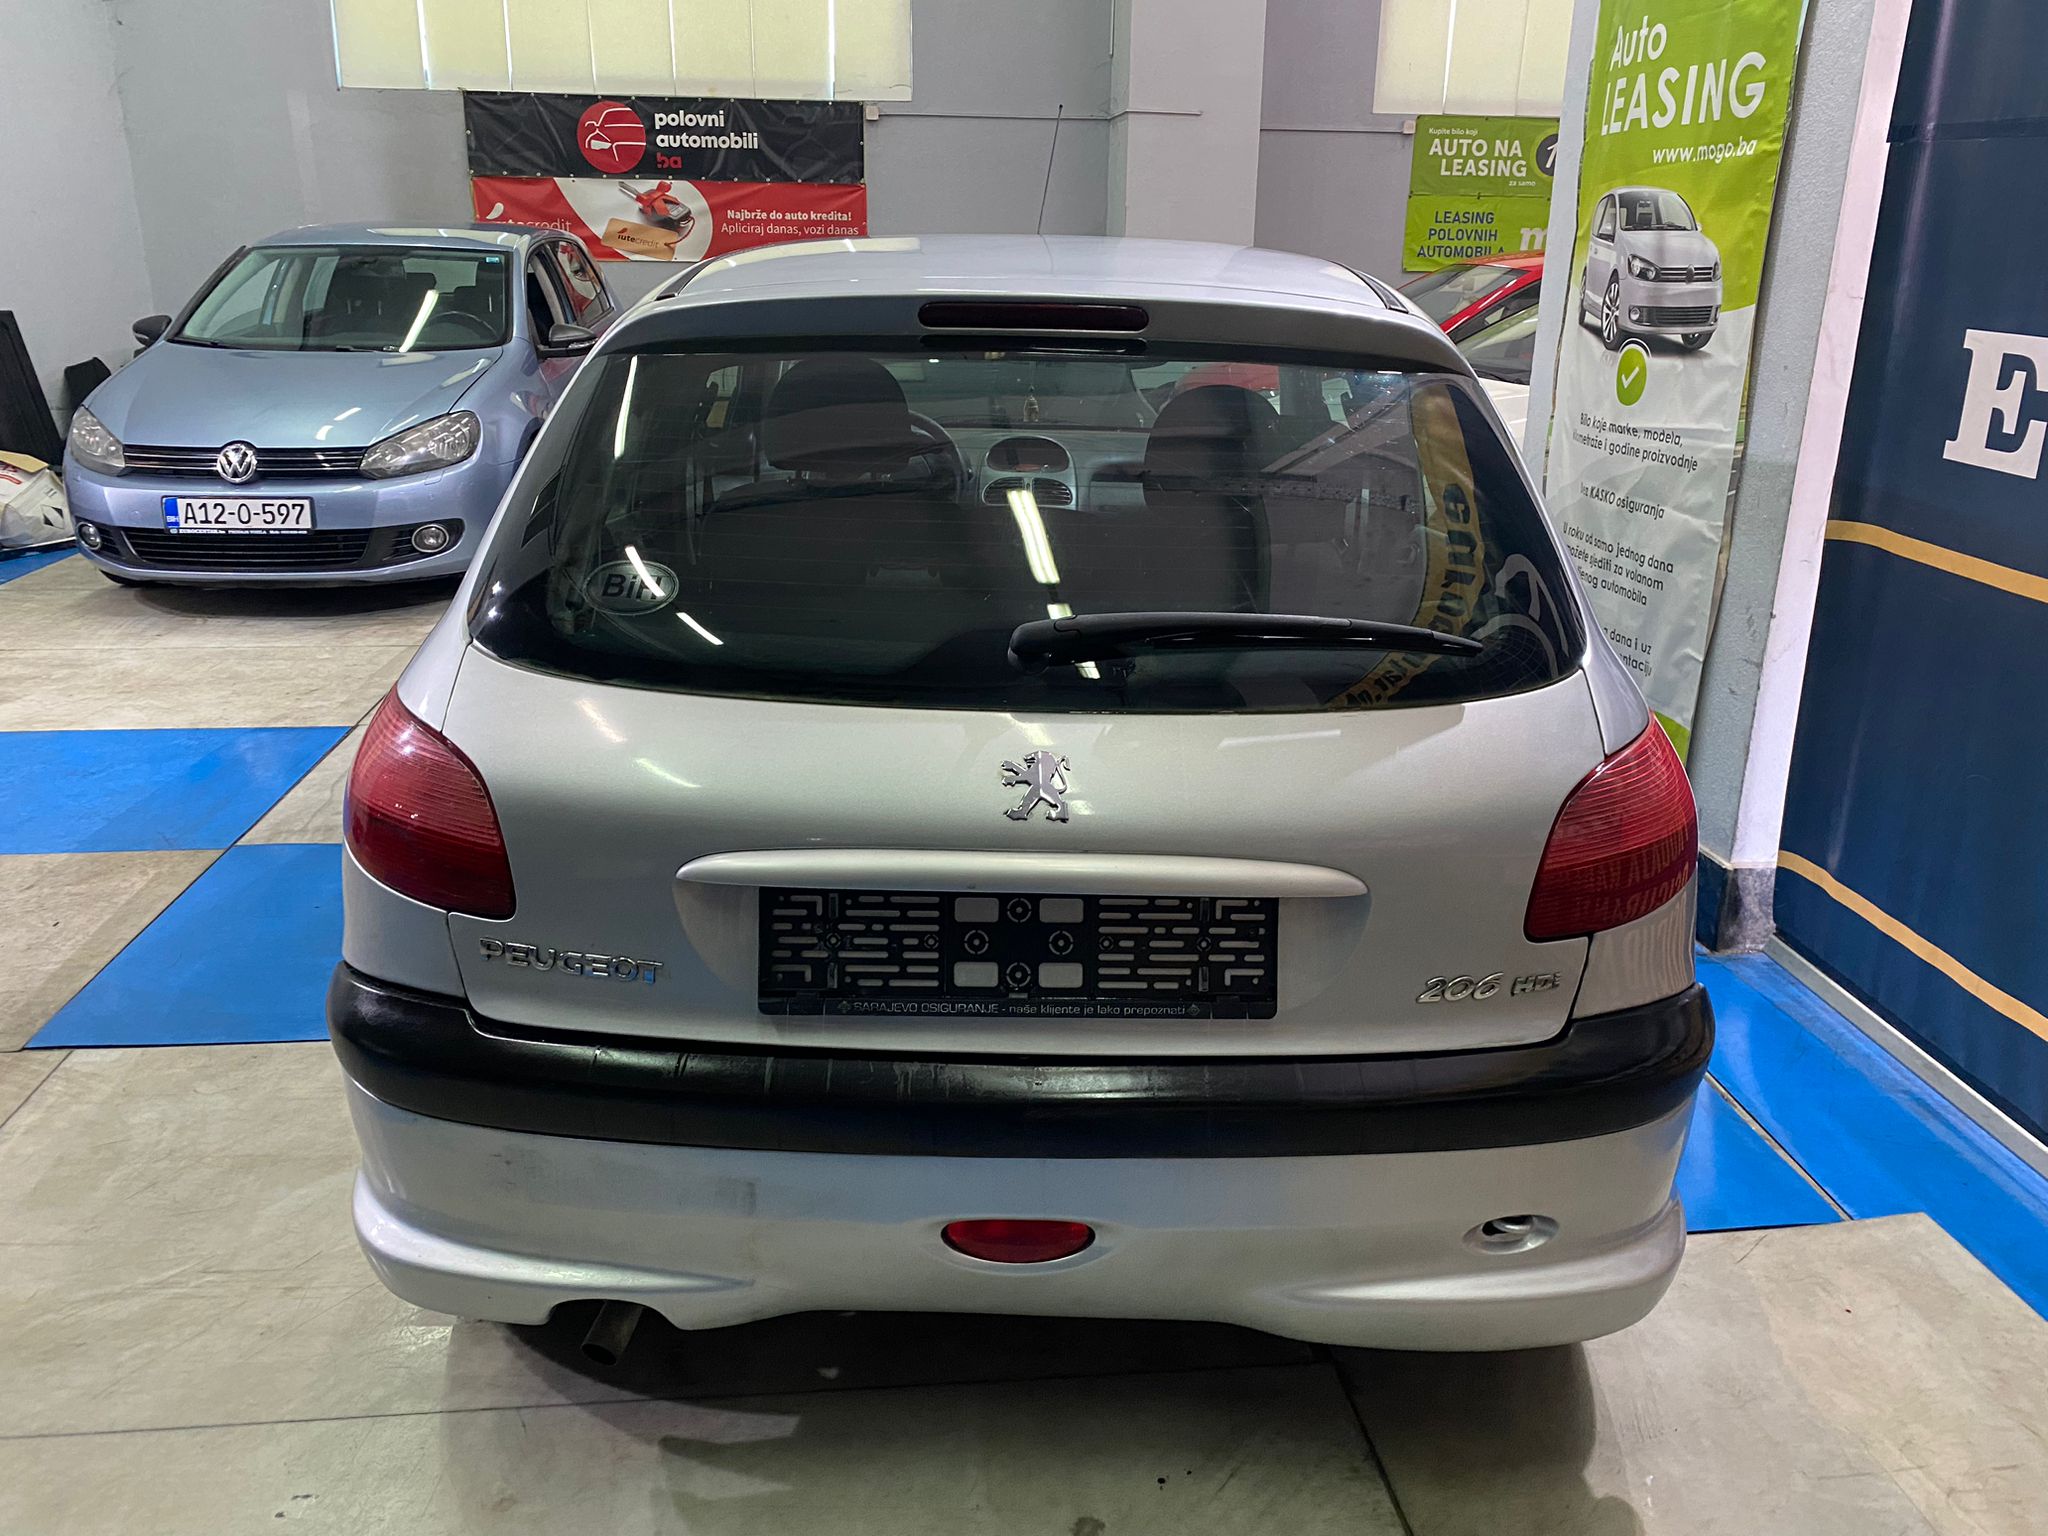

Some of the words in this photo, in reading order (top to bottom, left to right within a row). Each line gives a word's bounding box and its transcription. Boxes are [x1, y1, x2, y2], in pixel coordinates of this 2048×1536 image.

[1609, 15, 1668, 72] Auto
[1601, 51, 1767, 136] LEASING
[654, 109, 725, 129] polovni
[1428, 127, 1450, 136] Kupite
[1465, 129, 1478, 137] koji
[656, 133, 759, 149] automobili
[1428, 138, 1488, 157] AUTO
[1494, 140, 1522, 157] NA
[1652, 136, 1758, 164] www.mogo.ba
[1440, 158, 1527, 177] LEASING
[727, 209, 767, 221] Najbrže
[769, 210, 783, 220] do
[784, 212, 808, 221] auto
[810, 210, 852, 221] kredita!
[1434, 210, 1495, 224] LEASING
[721, 222, 764, 235] Apliciraj
[766, 223, 801, 236] danas,
[803, 225, 825, 235] vozi
[826, 224, 859, 236] danas
[1428, 228, 1498, 241] POLOVNIH
[1580, 412, 1591, 425] Bilo
[1592, 416, 1607, 433] koje
[1608, 423, 1641, 439] marke,
[1643, 428, 1683, 448] modela,
[1608, 442, 1641, 458] godine
[1642, 449, 1698, 473] proizvodnje
[1589, 486, 1615, 504] KASKO
[1616, 496, 1665, 519] osiguranja
[1562, 522, 1568, 534] U
[1568, 526, 1585, 540] roku
[1585, 533, 1593, 545] od
[1594, 538, 1614, 553] samo
[1615, 542, 1646, 567] jednog
[1647, 555, 1674, 573] dana
[1590, 553, 1611, 571] sjediti
[1613, 563, 1624, 576] za
[1625, 568, 1664, 591] volanom
[1600, 580, 1647, 606] automobila
[1609, 629, 1632, 648] dana
[1634, 637, 1639, 651] i
[1641, 643, 1652, 655] uz
[479, 937, 664, 985] PEUGEOT
[1415, 972, 1504, 1004] 206
[853, 1001, 918, 1013] SARAJEVO
[921, 1002, 999, 1014] OSIGURANJE
[1008, 1004, 1037, 1014] naše
[1040, 1004, 1081, 1016] klijente
[1083, 1004, 1094, 1016] je
[1097, 1005, 1121, 1015] lako
[1123, 1006, 1186, 1017] prepoznati
